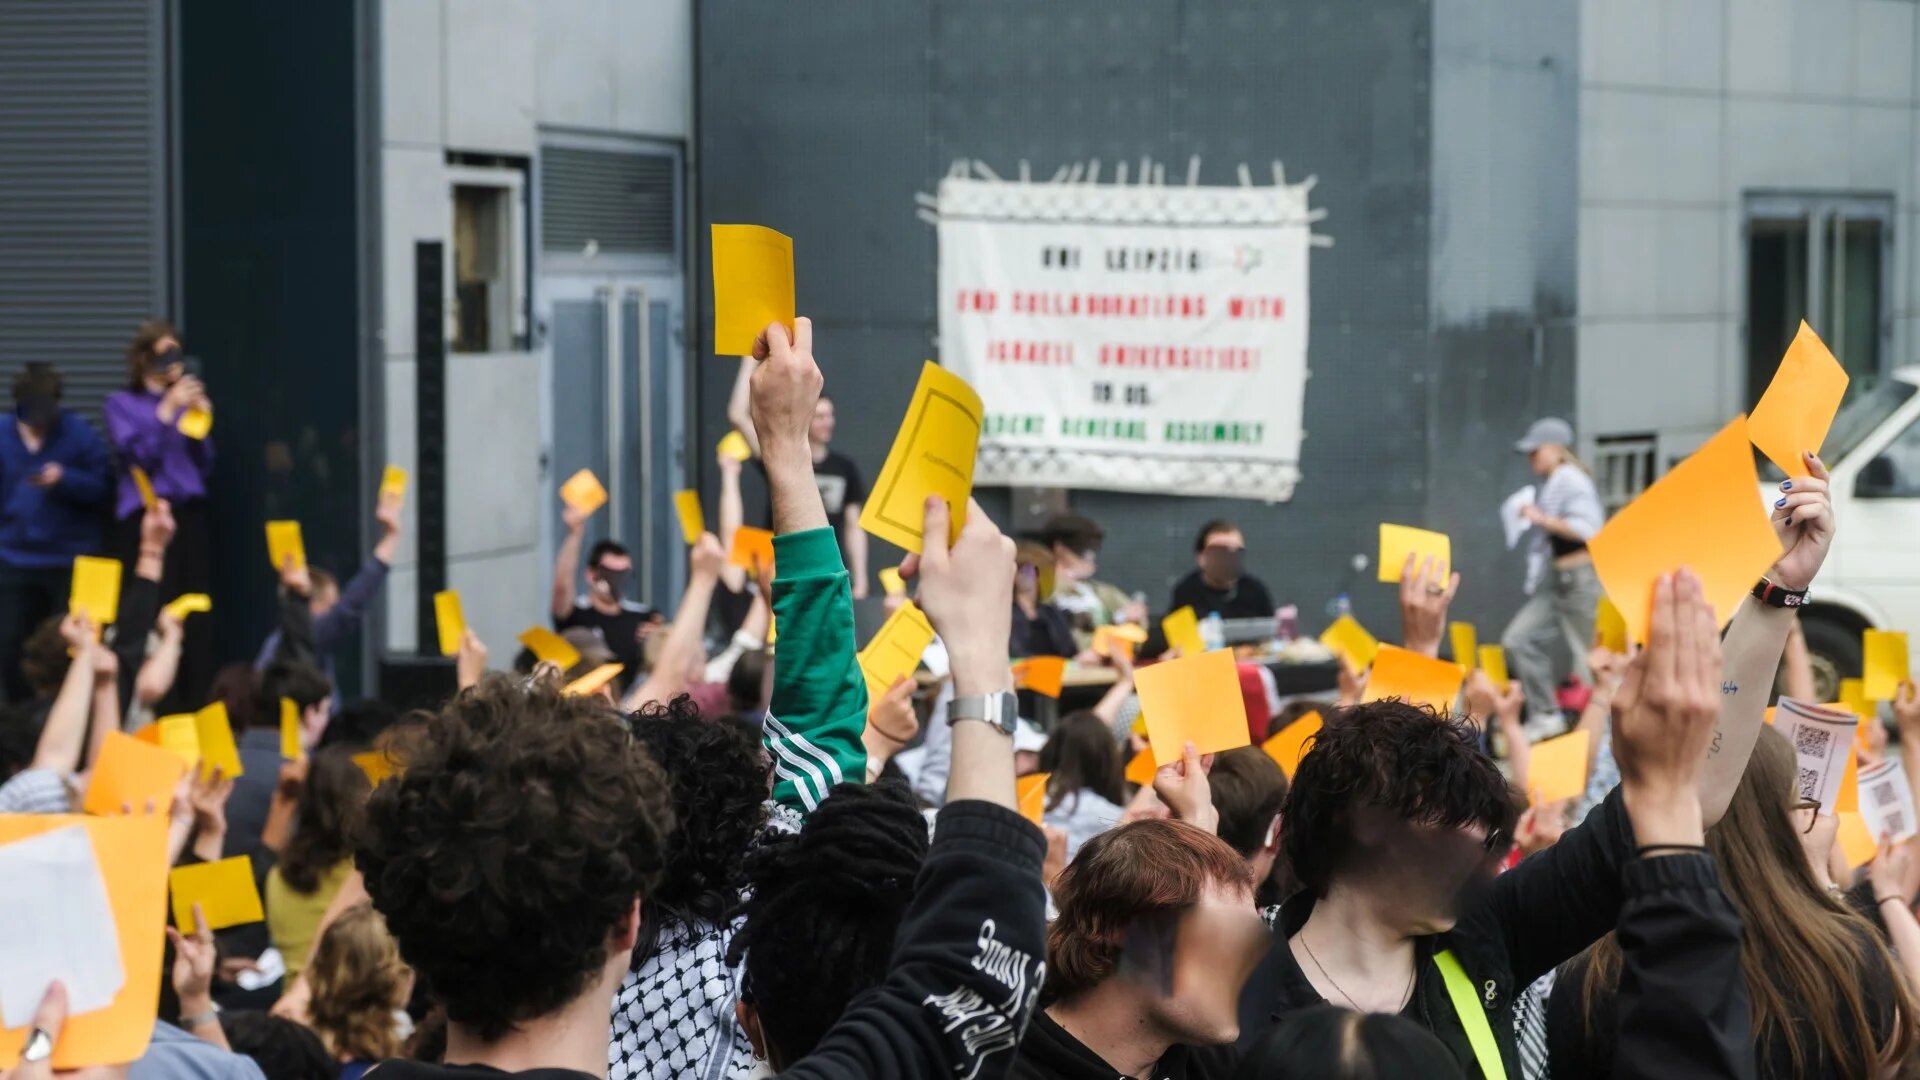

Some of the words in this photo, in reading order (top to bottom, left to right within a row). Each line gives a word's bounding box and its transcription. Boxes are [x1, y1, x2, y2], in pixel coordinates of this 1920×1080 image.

[1041, 246, 1081, 269] UNI
[956, 289, 998, 313] END
[1226, 295, 1285, 320] WITH
[986, 340, 1073, 366] ISRAELI
[1060, 415, 1146, 441] GENERAL
[1165, 419, 1263, 445] ASSEMBLY
